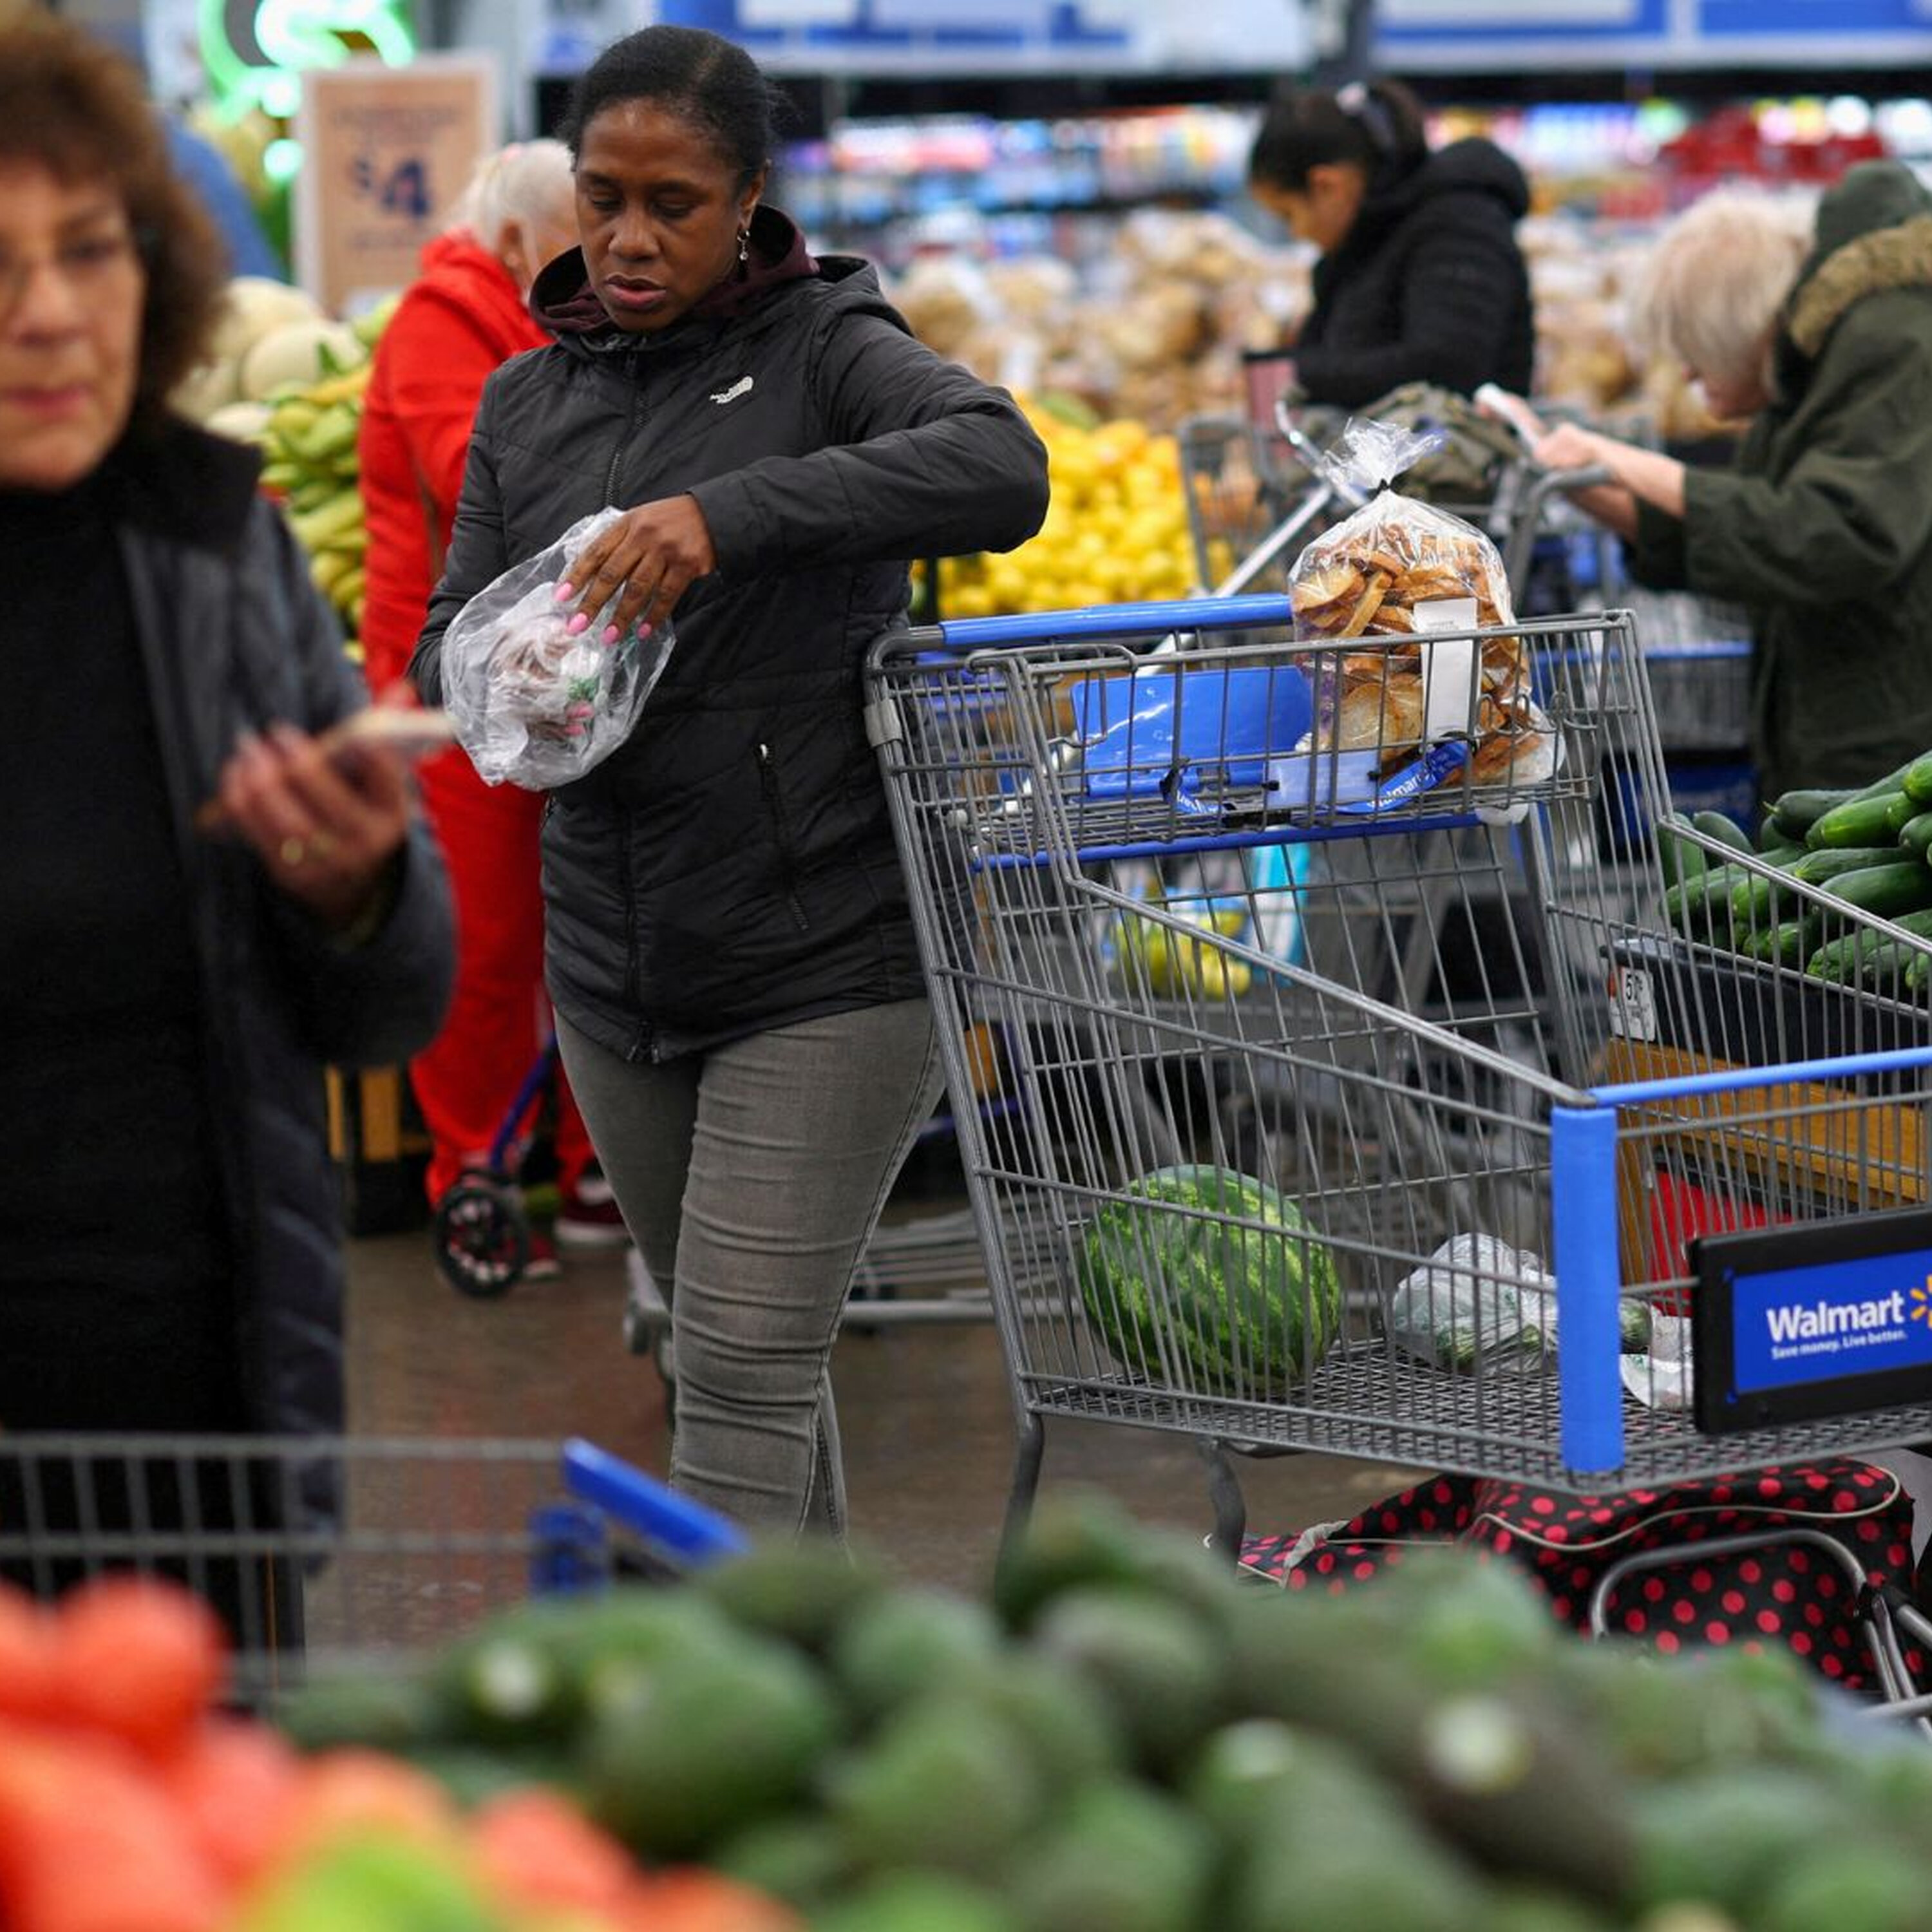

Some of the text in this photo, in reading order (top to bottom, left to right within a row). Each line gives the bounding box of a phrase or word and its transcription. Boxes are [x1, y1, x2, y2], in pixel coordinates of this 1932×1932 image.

[1366, 773, 1423, 808] Wlmar
[1766, 1290, 1904, 1343] Walmart
[1772, 1345, 1799, 1360] Save
[1842, 1334, 1867, 1349] Live
[1868, 1329, 1907, 1345] better.
